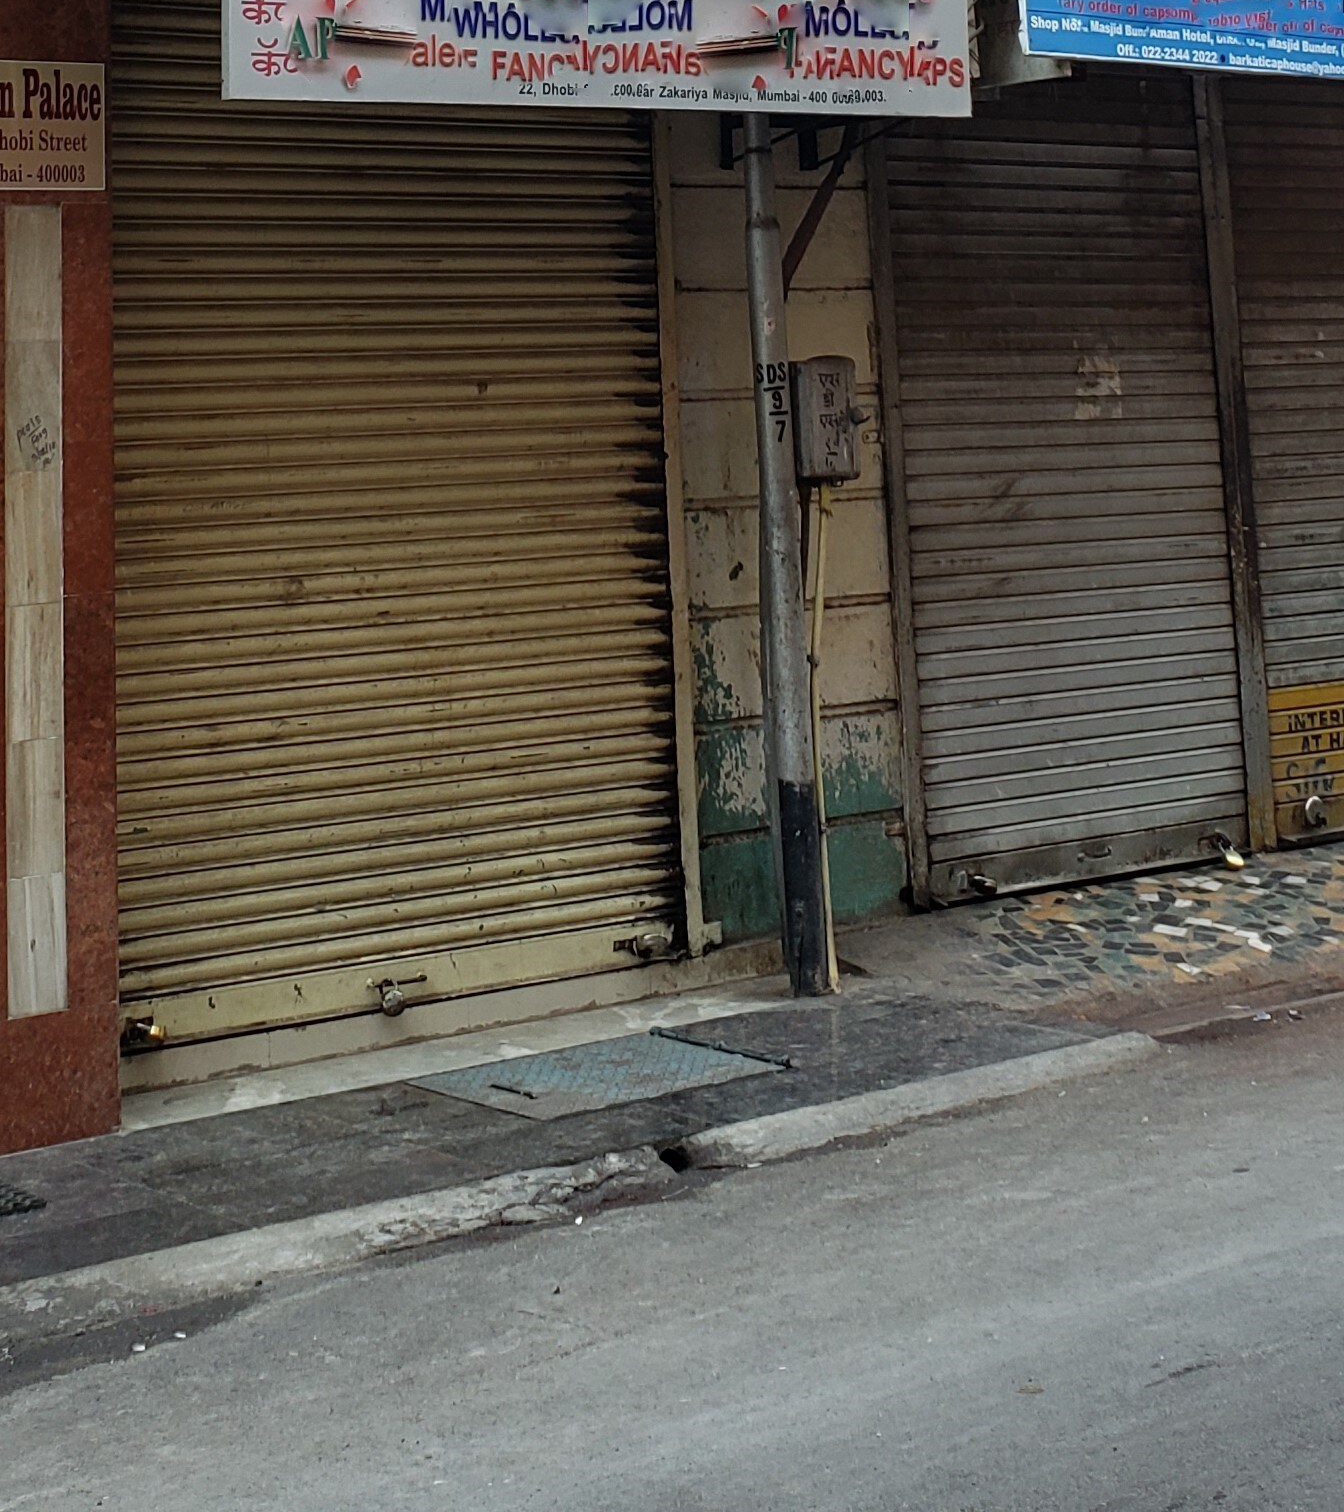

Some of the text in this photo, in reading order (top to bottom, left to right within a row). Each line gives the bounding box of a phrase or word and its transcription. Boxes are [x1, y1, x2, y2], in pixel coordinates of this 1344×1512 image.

[1126, 3, 1138, 15] of
[1030, 15, 1059, 33] Shop
[1090, 20, 1123, 37] Masjid
[1182, 29, 1215, 45] Hotel,
[1141, 45, 1190, 61] 022-2344
[1192, 50, 1218, 64] 2022
[1267, 38, 1299, 54] Masjid
[1302, 39, 1338, 56] Bunder,
[22, 68, 101, 121] Palace
[659, 85, 709, 102] Zakariya
[757, 89, 800, 103] Mumbai
[808, 91, 828, 103] 400
[38, 129, 88, 152] Street
[36, 164, 85, 182] 400003
[756, 361, 787, 384] SDS
[775, 420, 786, 442] 7
[1302, 735, 1322, 753] AT
